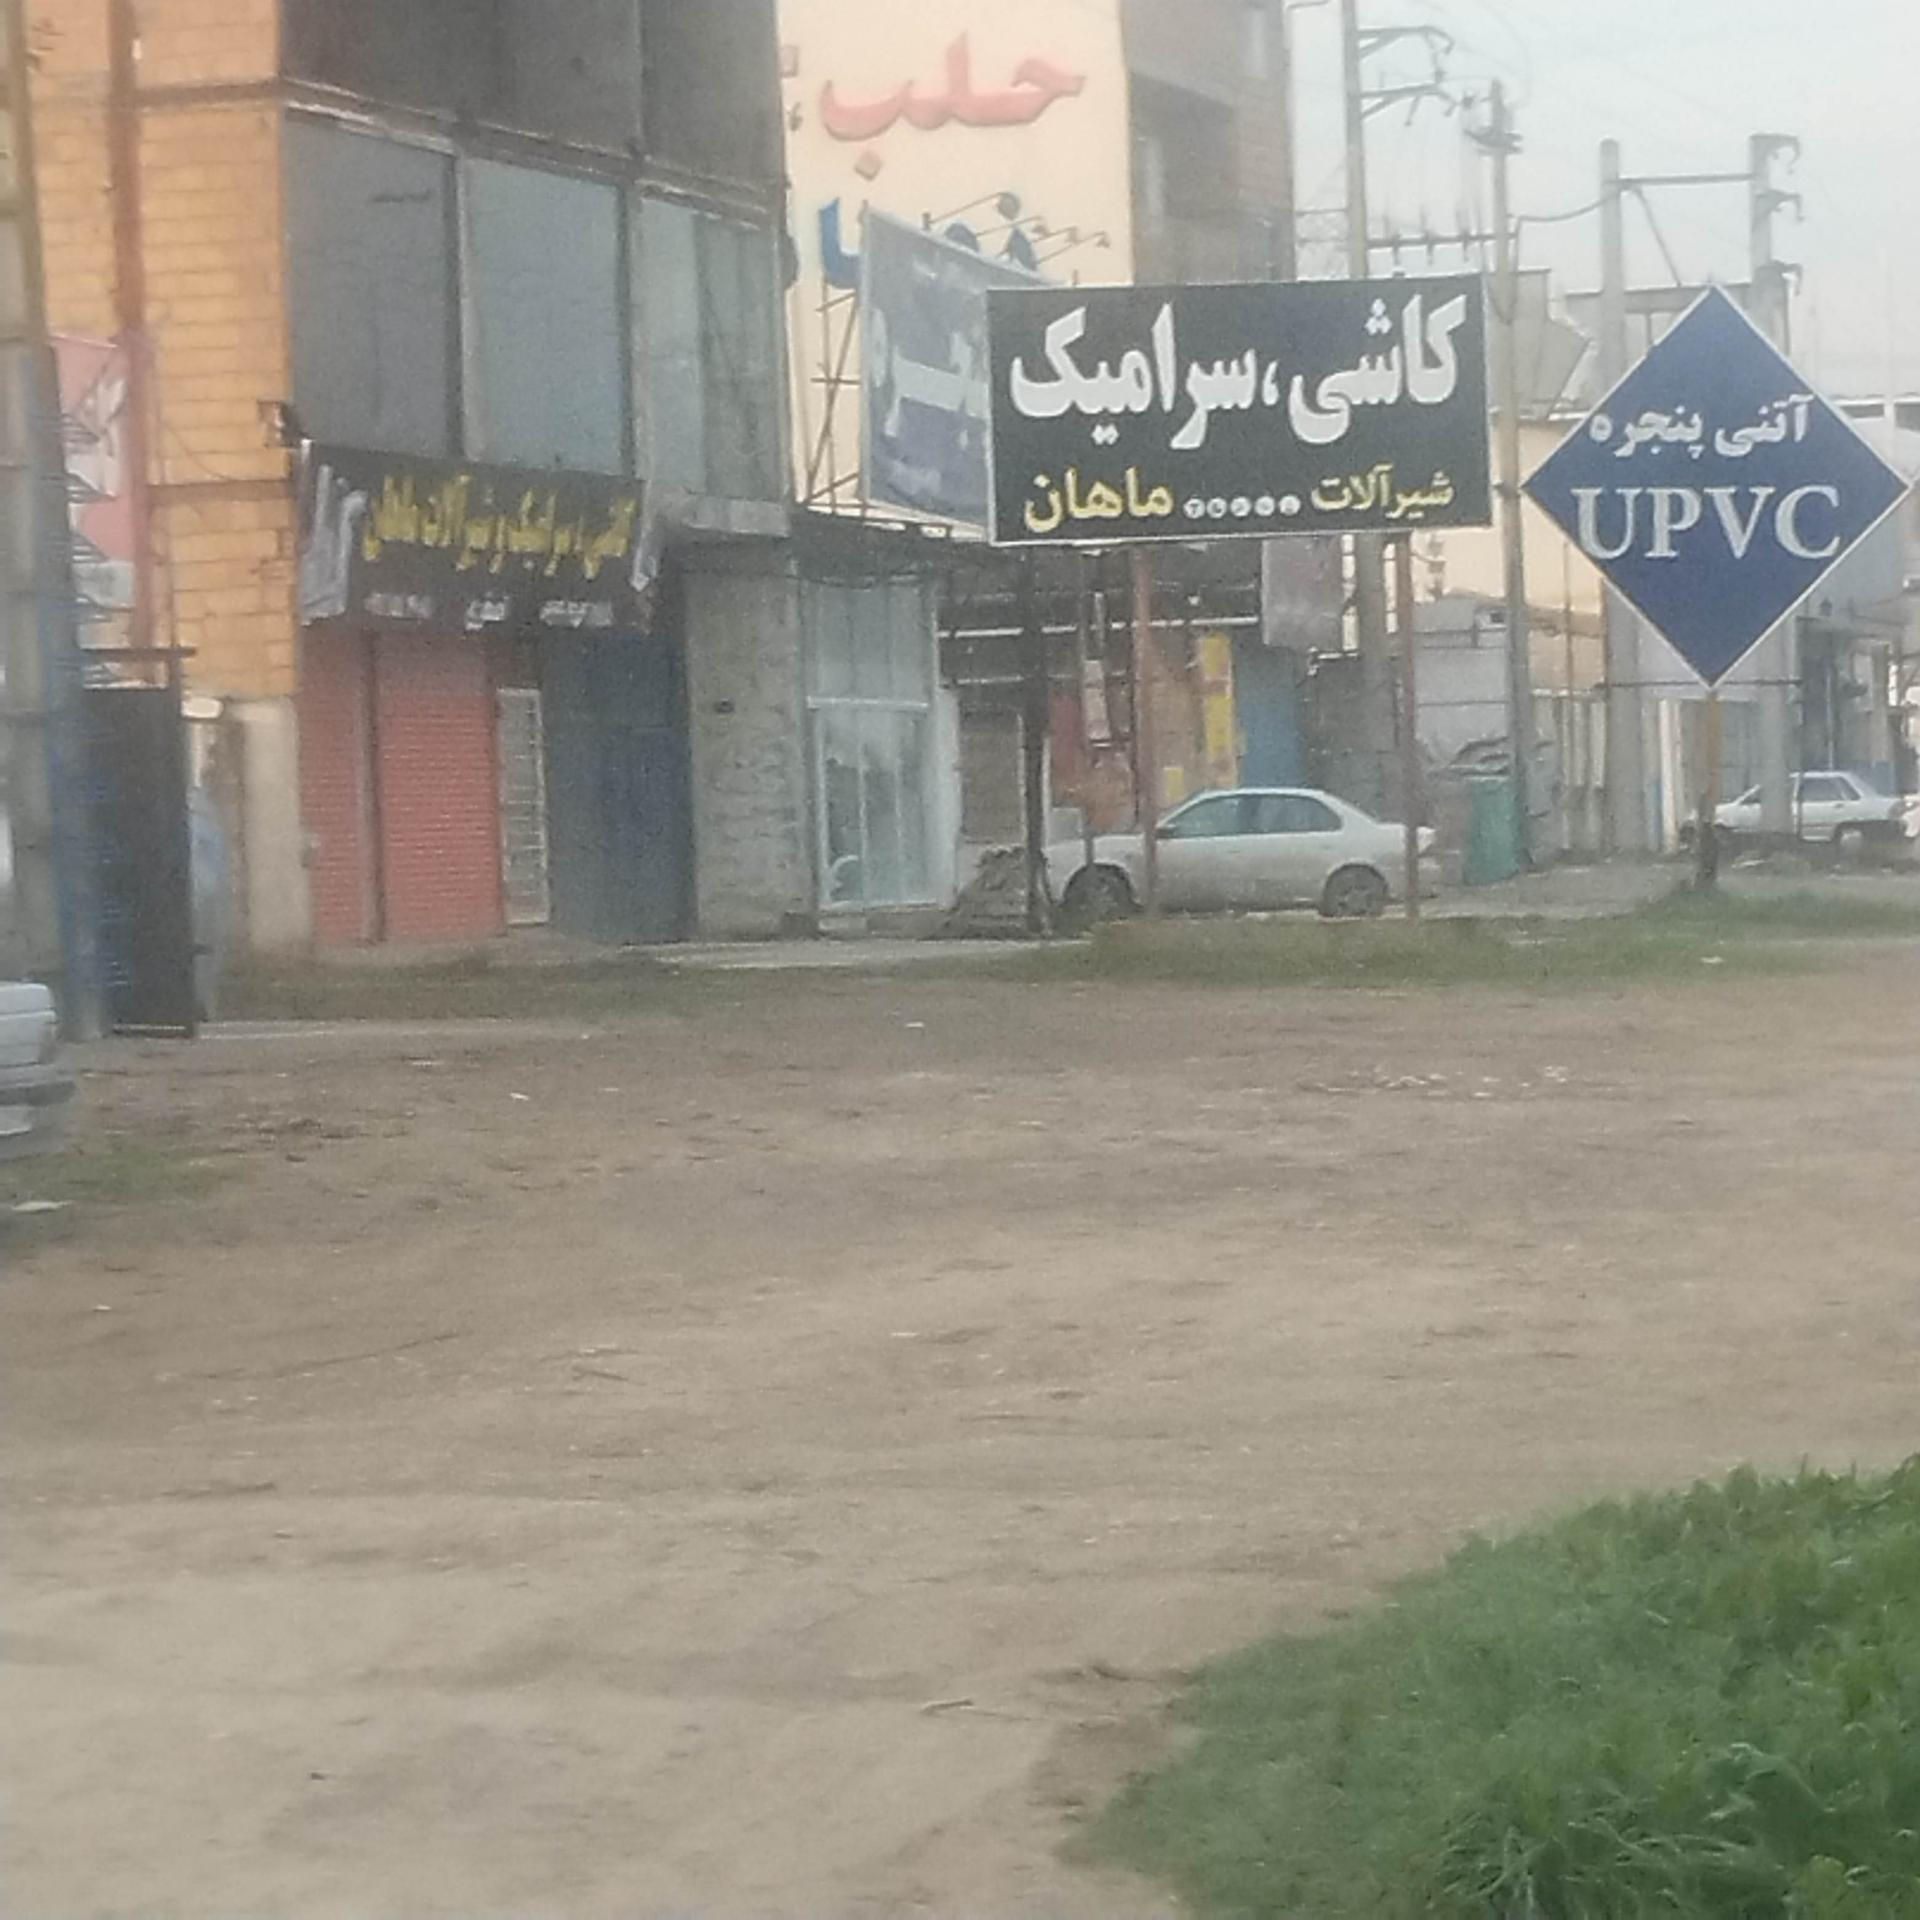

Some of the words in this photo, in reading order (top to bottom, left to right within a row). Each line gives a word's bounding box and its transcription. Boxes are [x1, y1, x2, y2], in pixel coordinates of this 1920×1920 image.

[1588, 405, 1705, 459] پنجره
[1023, 466, 1174, 532] ماهان
[1570, 485, 1842, 560] UPVC
